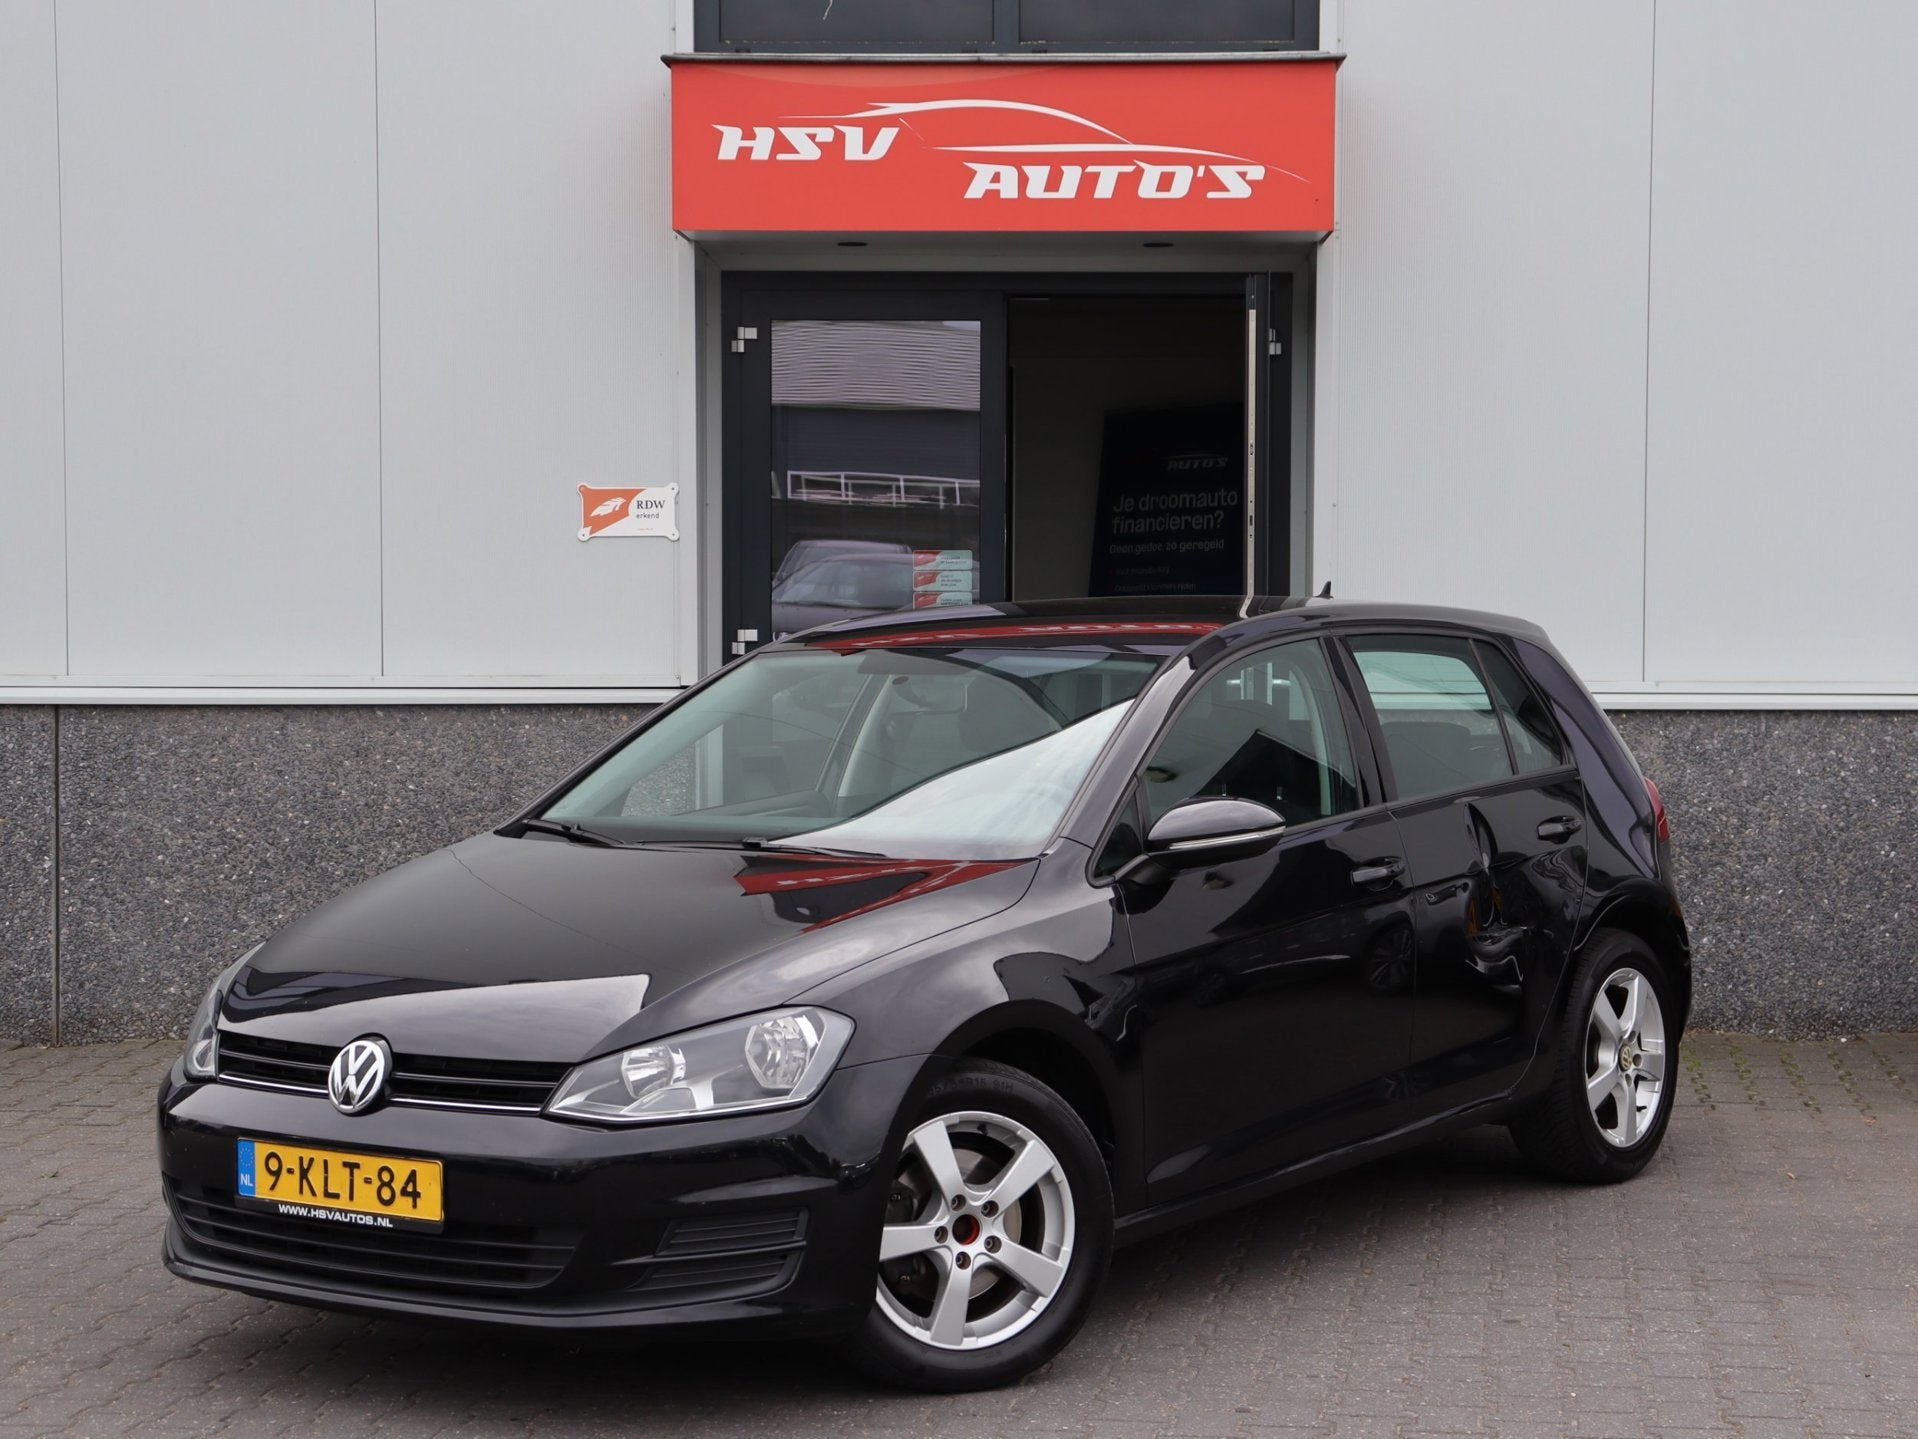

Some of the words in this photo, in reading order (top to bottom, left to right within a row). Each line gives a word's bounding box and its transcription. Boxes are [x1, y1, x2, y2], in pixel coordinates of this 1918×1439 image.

[712, 123, 900, 161] HSV
[962, 159, 1266, 199] AUTO'S
[636, 500, 665, 509] RDW
[1112, 495, 1135, 512] Je
[1138, 490, 1237, 511] droomauto
[1112, 511, 1225, 534] financieren?
[240, 1173, 254, 1187] NL
[264, 1151, 421, 1209] 9-KLT-84
[278, 1203, 393, 1228] WWW.HSVAUTOS.NL
